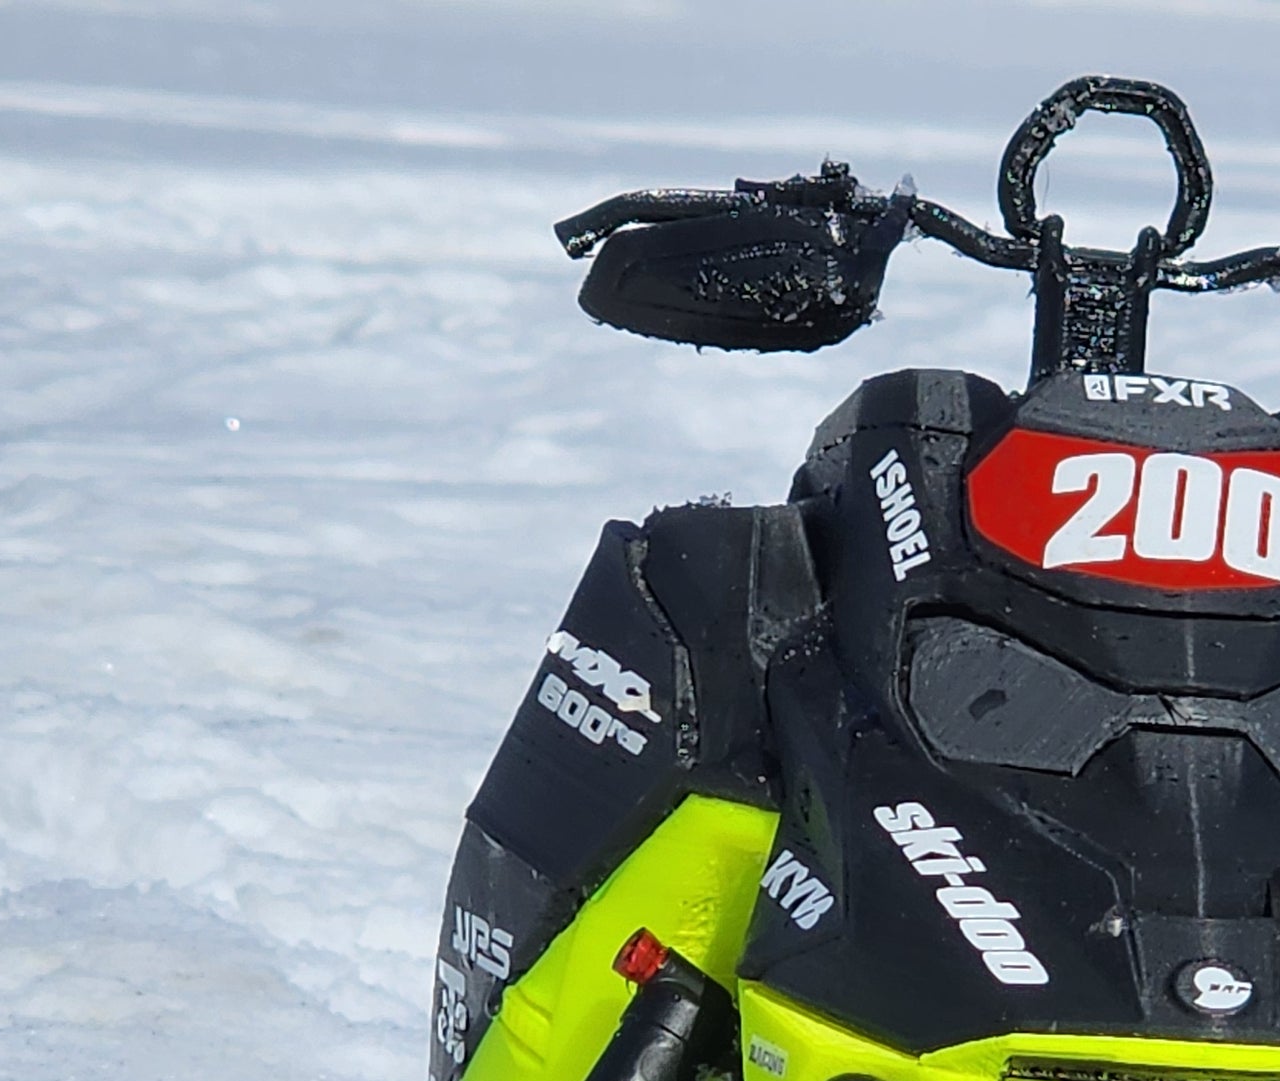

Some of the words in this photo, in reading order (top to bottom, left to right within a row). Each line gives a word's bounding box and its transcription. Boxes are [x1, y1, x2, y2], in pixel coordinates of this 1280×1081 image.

[1114, 375, 1232, 411] FXR
[870, 449, 931, 582] ISHOEL
[760, 849, 835, 930] KYB
